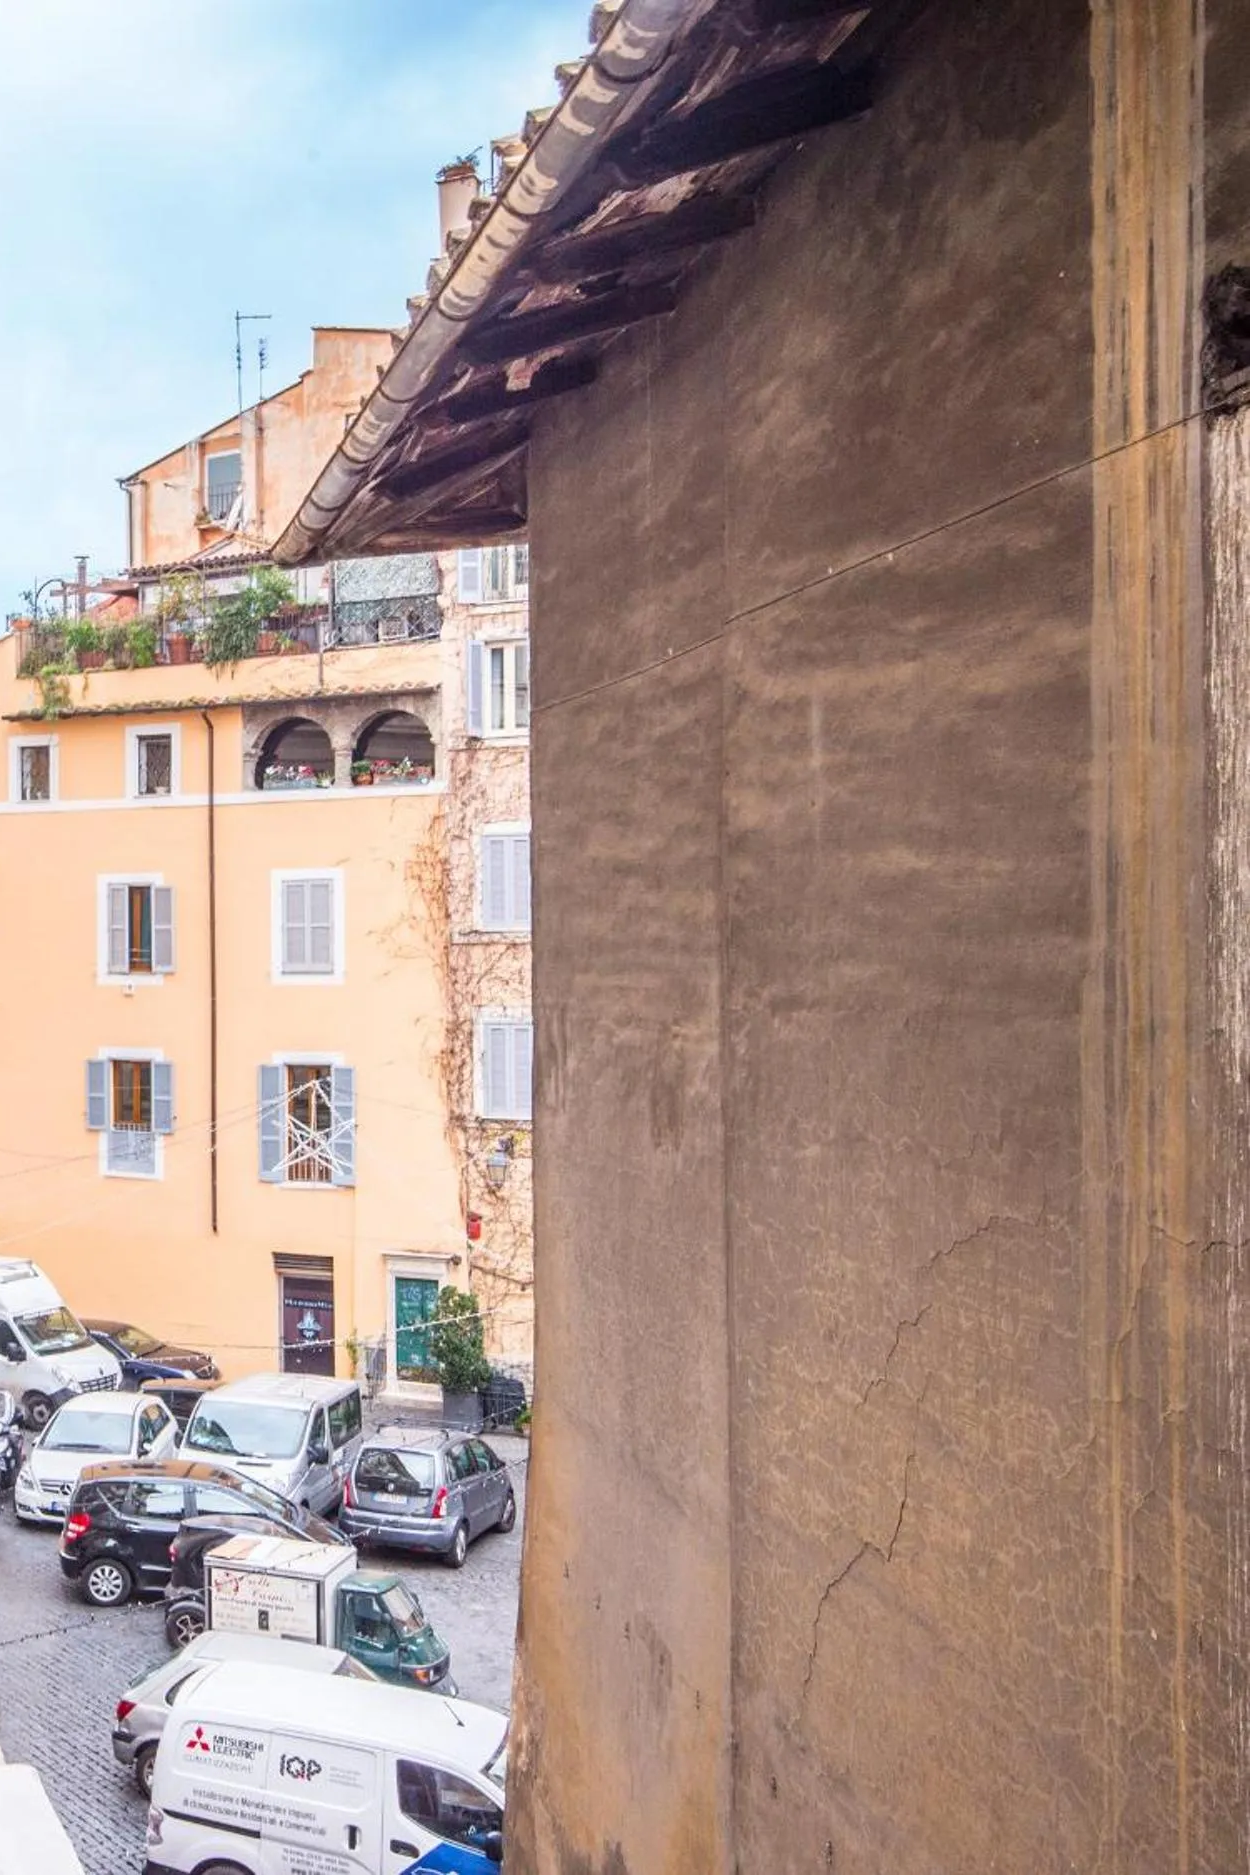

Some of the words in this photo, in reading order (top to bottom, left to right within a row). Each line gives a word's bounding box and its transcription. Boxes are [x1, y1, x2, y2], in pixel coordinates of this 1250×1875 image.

[213, 1735, 264, 1752] MITSUBISHI
[213, 1745, 255, 1760] ELECTRIC
[279, 1753, 322, 1781] IQP
